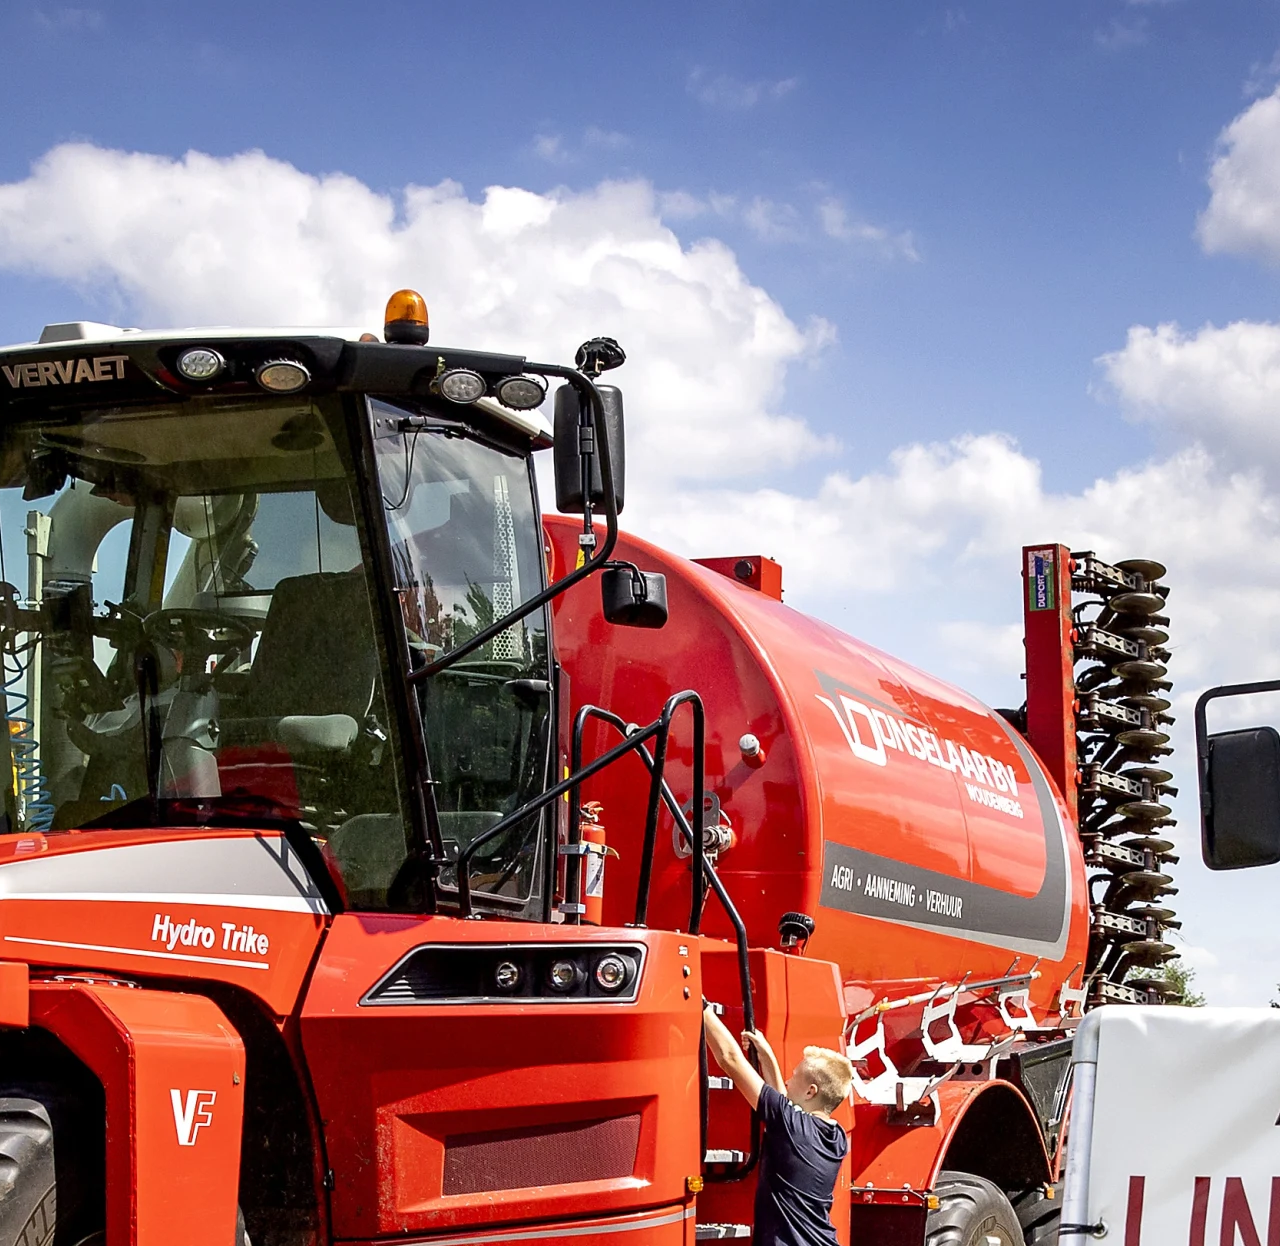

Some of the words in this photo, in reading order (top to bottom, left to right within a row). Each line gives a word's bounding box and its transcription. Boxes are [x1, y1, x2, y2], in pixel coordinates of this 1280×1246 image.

[1, 355, 129, 388] VERVAET
[815, 694, 995, 789] DONSELAAR
[989, 757, 1019, 797] BV
[965, 782, 1024, 819] WOUDENBERG
[831, 864, 854, 892] AGRI
[863, 873, 916, 908] AANNEMING
[926, 889, 963, 919] VERHUUR
[151, 913, 216, 951] Hydro
[221, 922, 269, 955] Trike
[169, 1088, 217, 1146] VF
